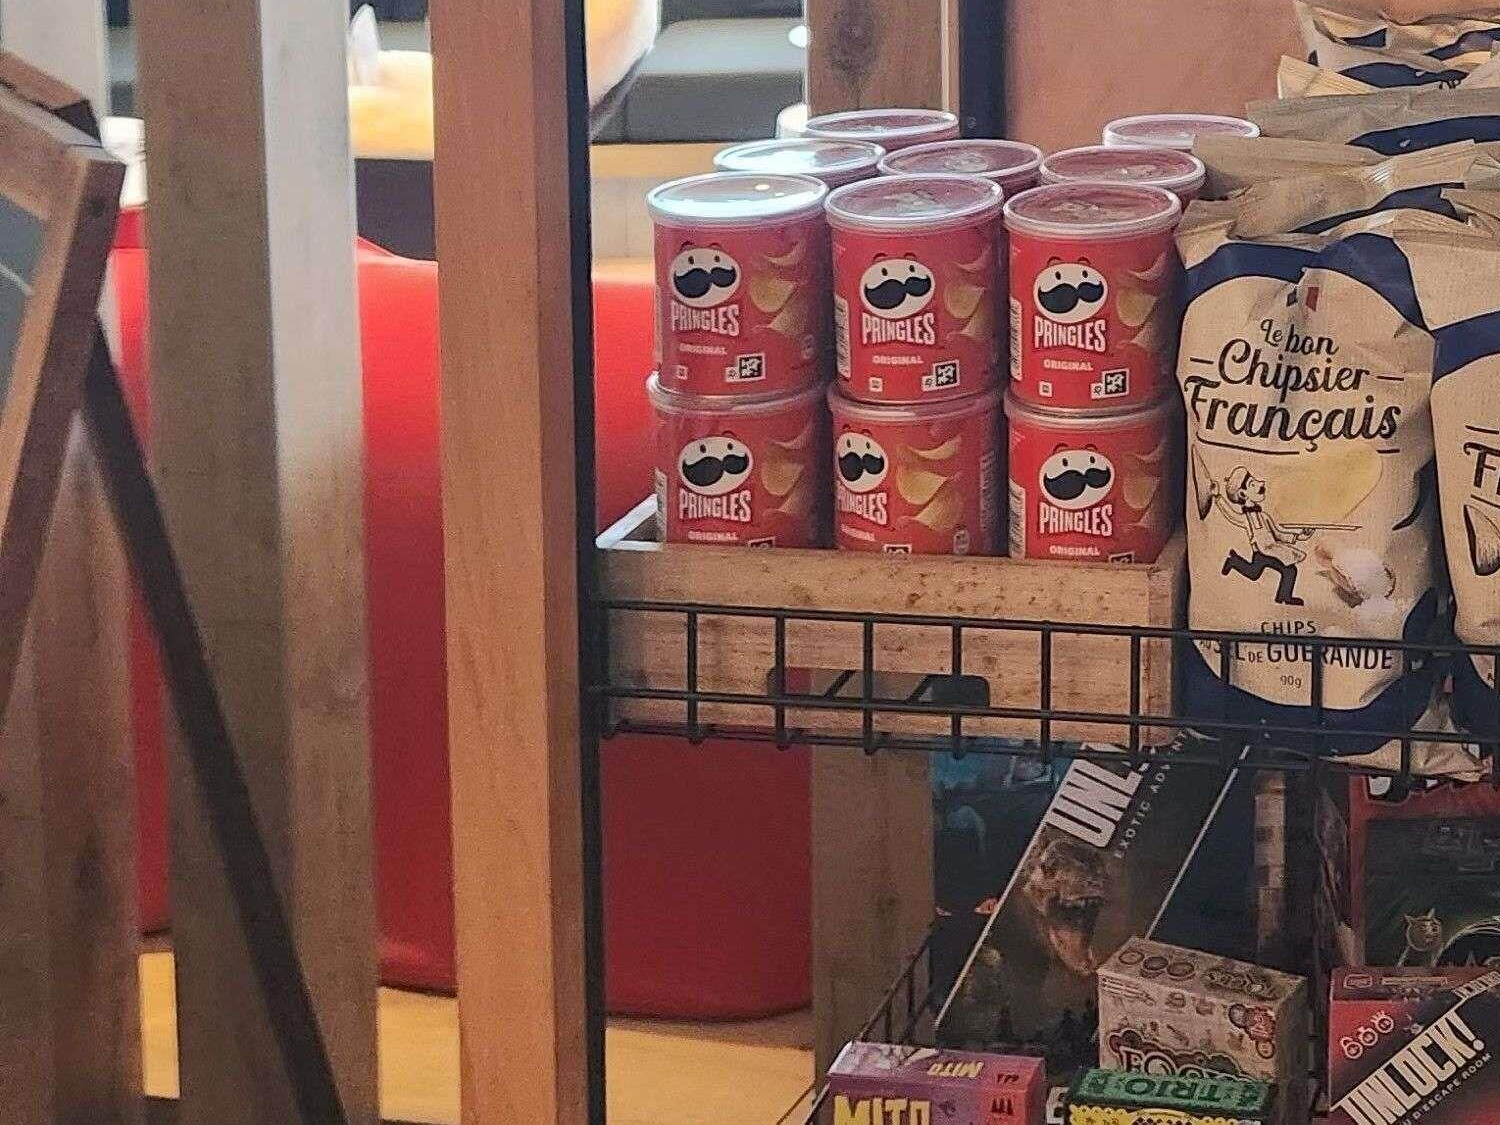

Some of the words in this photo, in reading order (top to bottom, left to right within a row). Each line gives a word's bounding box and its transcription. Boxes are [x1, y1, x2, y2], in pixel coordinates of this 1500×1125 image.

[670, 299, 741, 337] PRINGLES
[861, 312, 936, 346] PRINGLES
[1033, 315, 1107, 352] PRINGLES
[1260, 318, 1284, 347] Le
[1285, 324, 1340, 355] bon
[872, 354, 924, 365] ORIGINAL
[1043, 359, 1094, 372] ORIGINAL
[1218, 338, 1371, 403] Chipsier
[1184, 375, 1402, 452] Français
[678, 487, 752, 523] PRINGLES
[1038, 501, 1114, 537] PRINGLES
[687, 530, 740, 542] ORIGINAL
[1049, 544, 1102, 557] ORIGINAL
[1260, 620, 1317, 636] CHIPS
[1248, 652, 1264, 663] DE
[1279, 674, 1303, 689] 90g
[1463, 1052, 1493, 1081] ROOM
